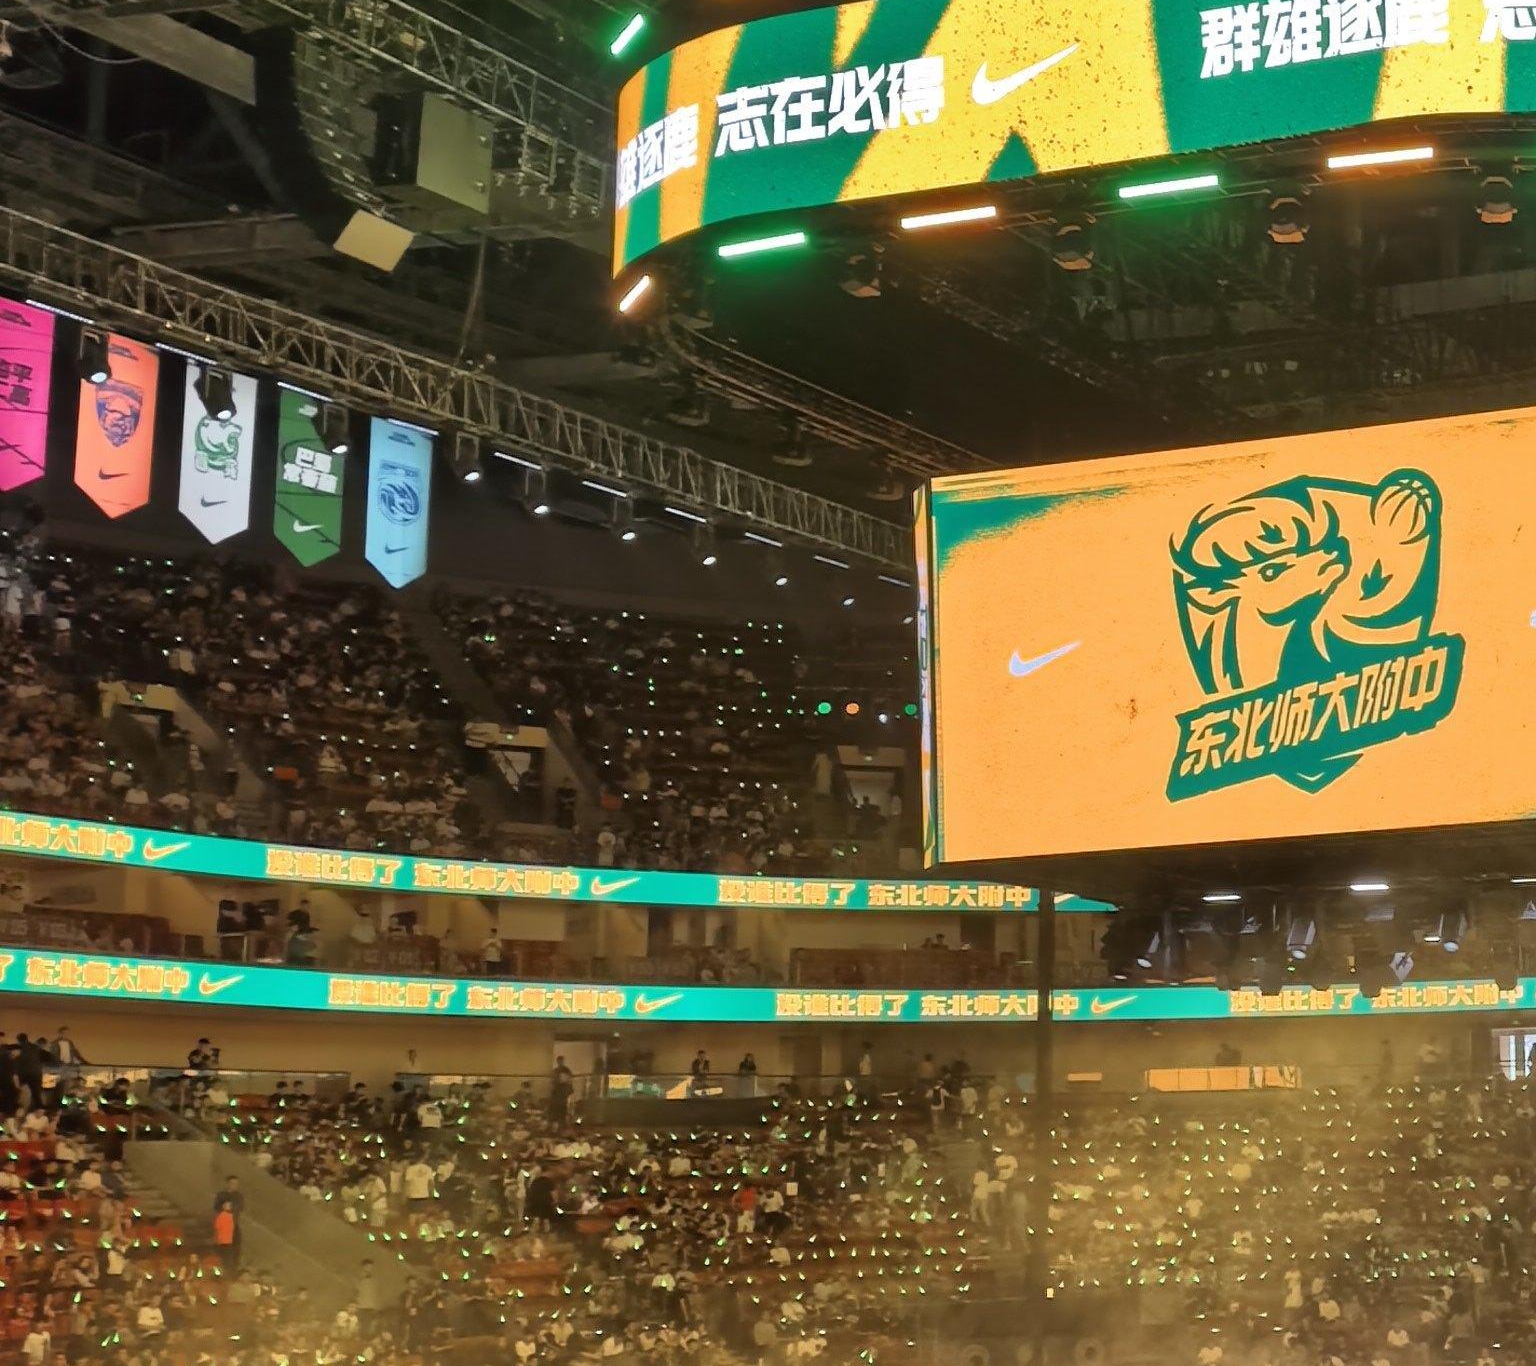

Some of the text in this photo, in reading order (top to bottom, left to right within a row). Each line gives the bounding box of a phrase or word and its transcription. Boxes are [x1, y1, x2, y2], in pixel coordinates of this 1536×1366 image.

[715, 55, 944, 158] 志在必得
[1180, 645, 1448, 777] 东北师大附中
[413, 861, 580, 897] 东北师大附中
[718, 879, 1032, 908] 没谁比得了 东北师大附中
[776, 993, 1079, 1018] 没谁比得了 东北师大中
